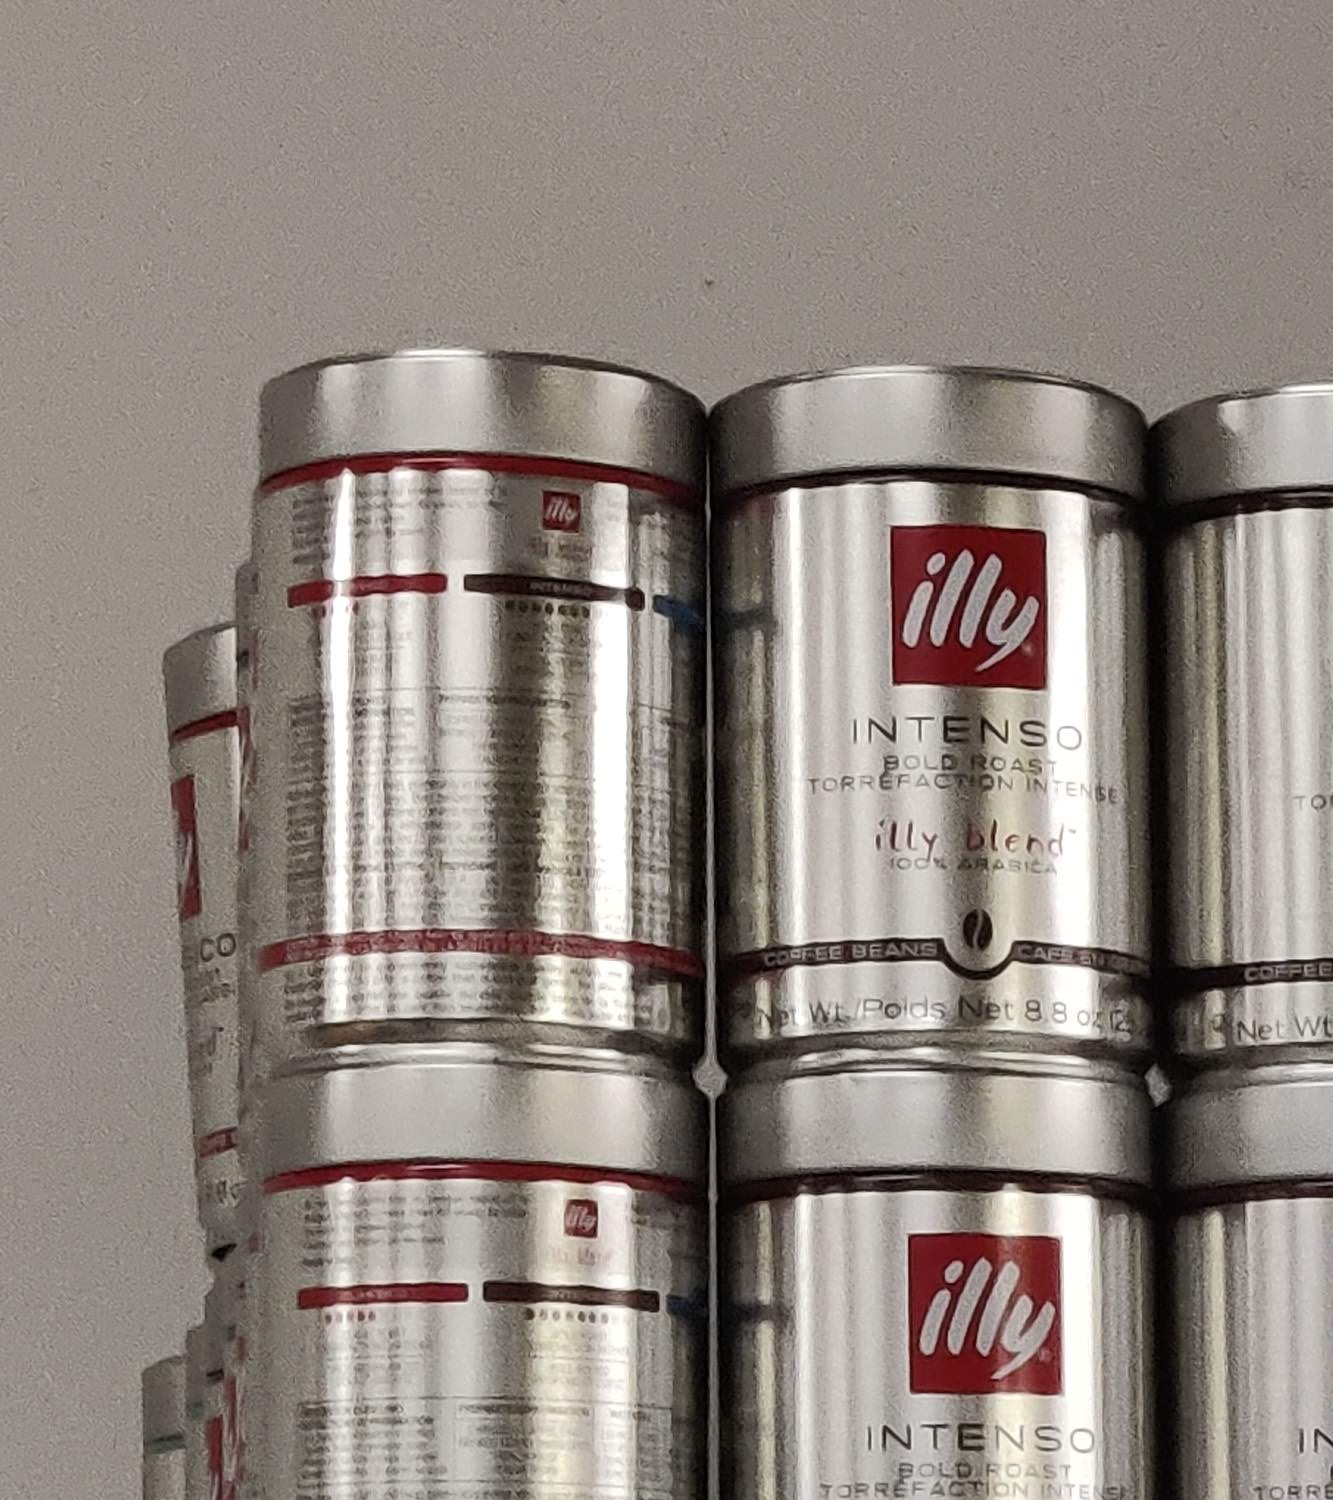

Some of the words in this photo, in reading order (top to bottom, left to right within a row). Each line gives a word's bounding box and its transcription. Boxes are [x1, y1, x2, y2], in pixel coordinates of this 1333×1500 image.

[902, 549, 1039, 672] illy
[853, 717, 1082, 750] INTENSO
[875, 819, 938, 861] illy
[852, 943, 938, 958] BEANS
[1244, 964, 1331, 982] COFFEE
[959, 1000, 1014, 1020] Net
[1237, 1022, 1284, 1041] Net
[919, 1257, 1056, 1380] illy
[867, 1424, 1095, 1454] INTENSO
